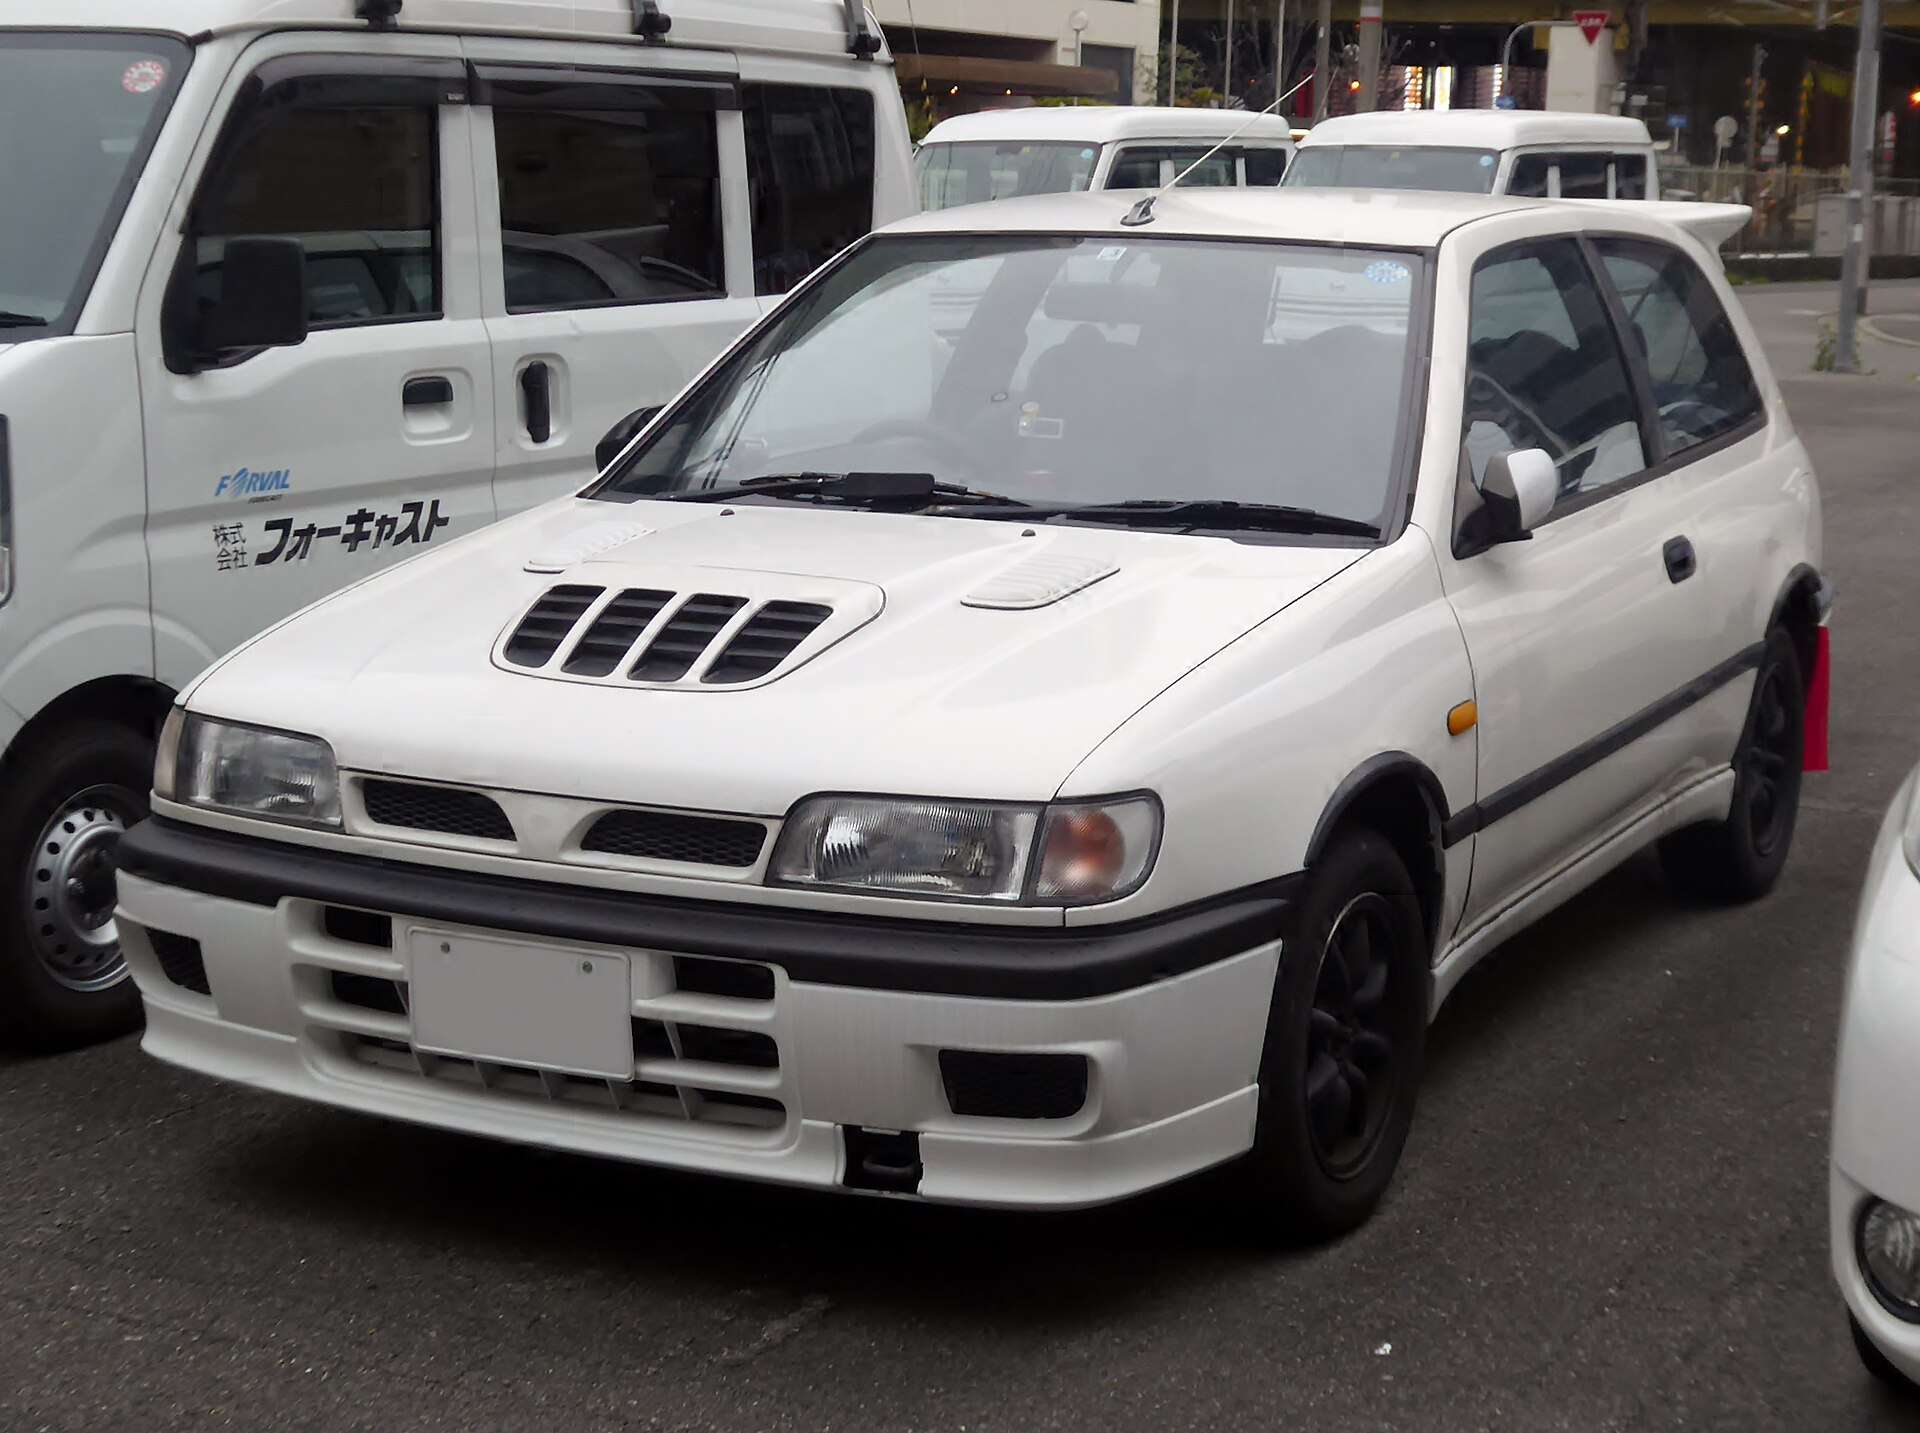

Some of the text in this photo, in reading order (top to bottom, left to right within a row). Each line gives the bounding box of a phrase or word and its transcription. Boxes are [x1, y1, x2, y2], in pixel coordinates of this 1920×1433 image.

[215, 468, 291, 496] FORVAL
[212, 522, 247, 546] 株式
[255, 499, 450, 566] フォーキャスト
[217, 547, 248, 571] 会社
